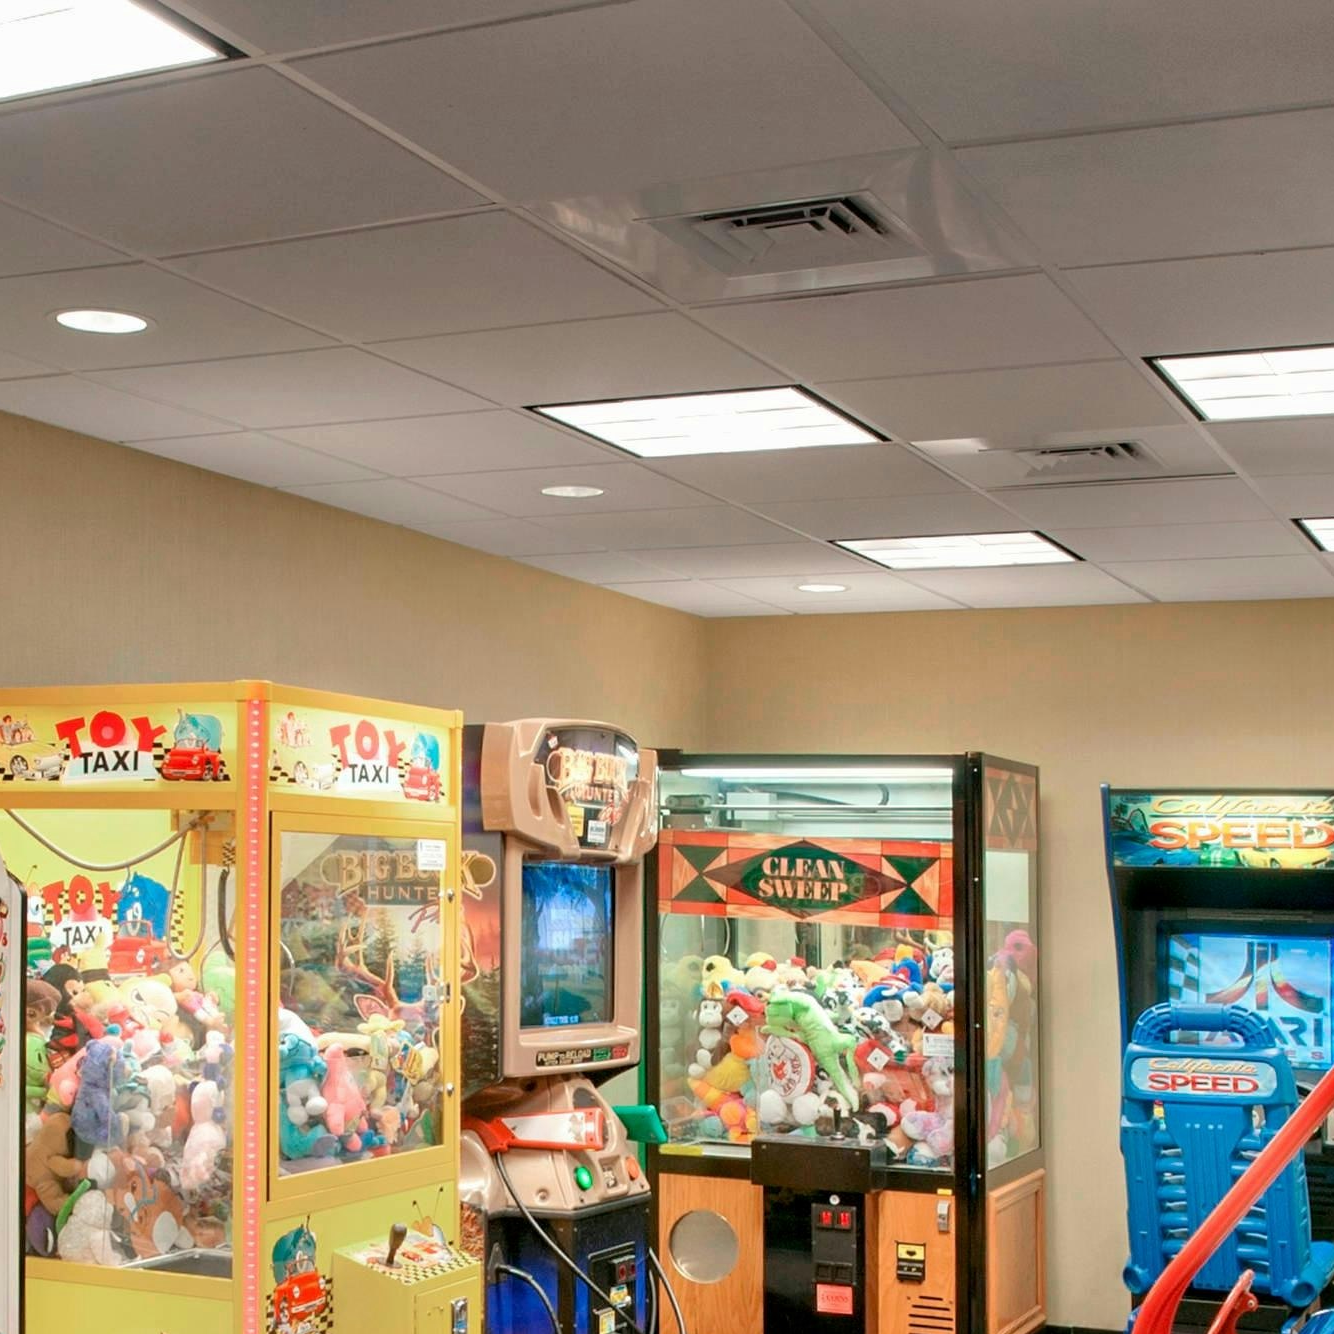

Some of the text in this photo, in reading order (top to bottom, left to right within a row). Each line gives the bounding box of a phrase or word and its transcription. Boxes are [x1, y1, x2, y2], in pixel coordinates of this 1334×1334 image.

[55, 710, 167, 758] TOY
[329, 719, 406, 767] TOY
[80, 750, 139, 775] TAXI
[349, 763, 391, 784] TAXI
[336, 852, 390, 897] BIG
[762, 856, 845, 880] CLEAN
[43, 875, 122, 923] TOY
[368, 886, 439, 900] HUNTE
[758, 878, 848, 902] SWEEP
[1148, 1058, 1257, 1074] California
[1148, 1074, 1259, 1094] SPEED
